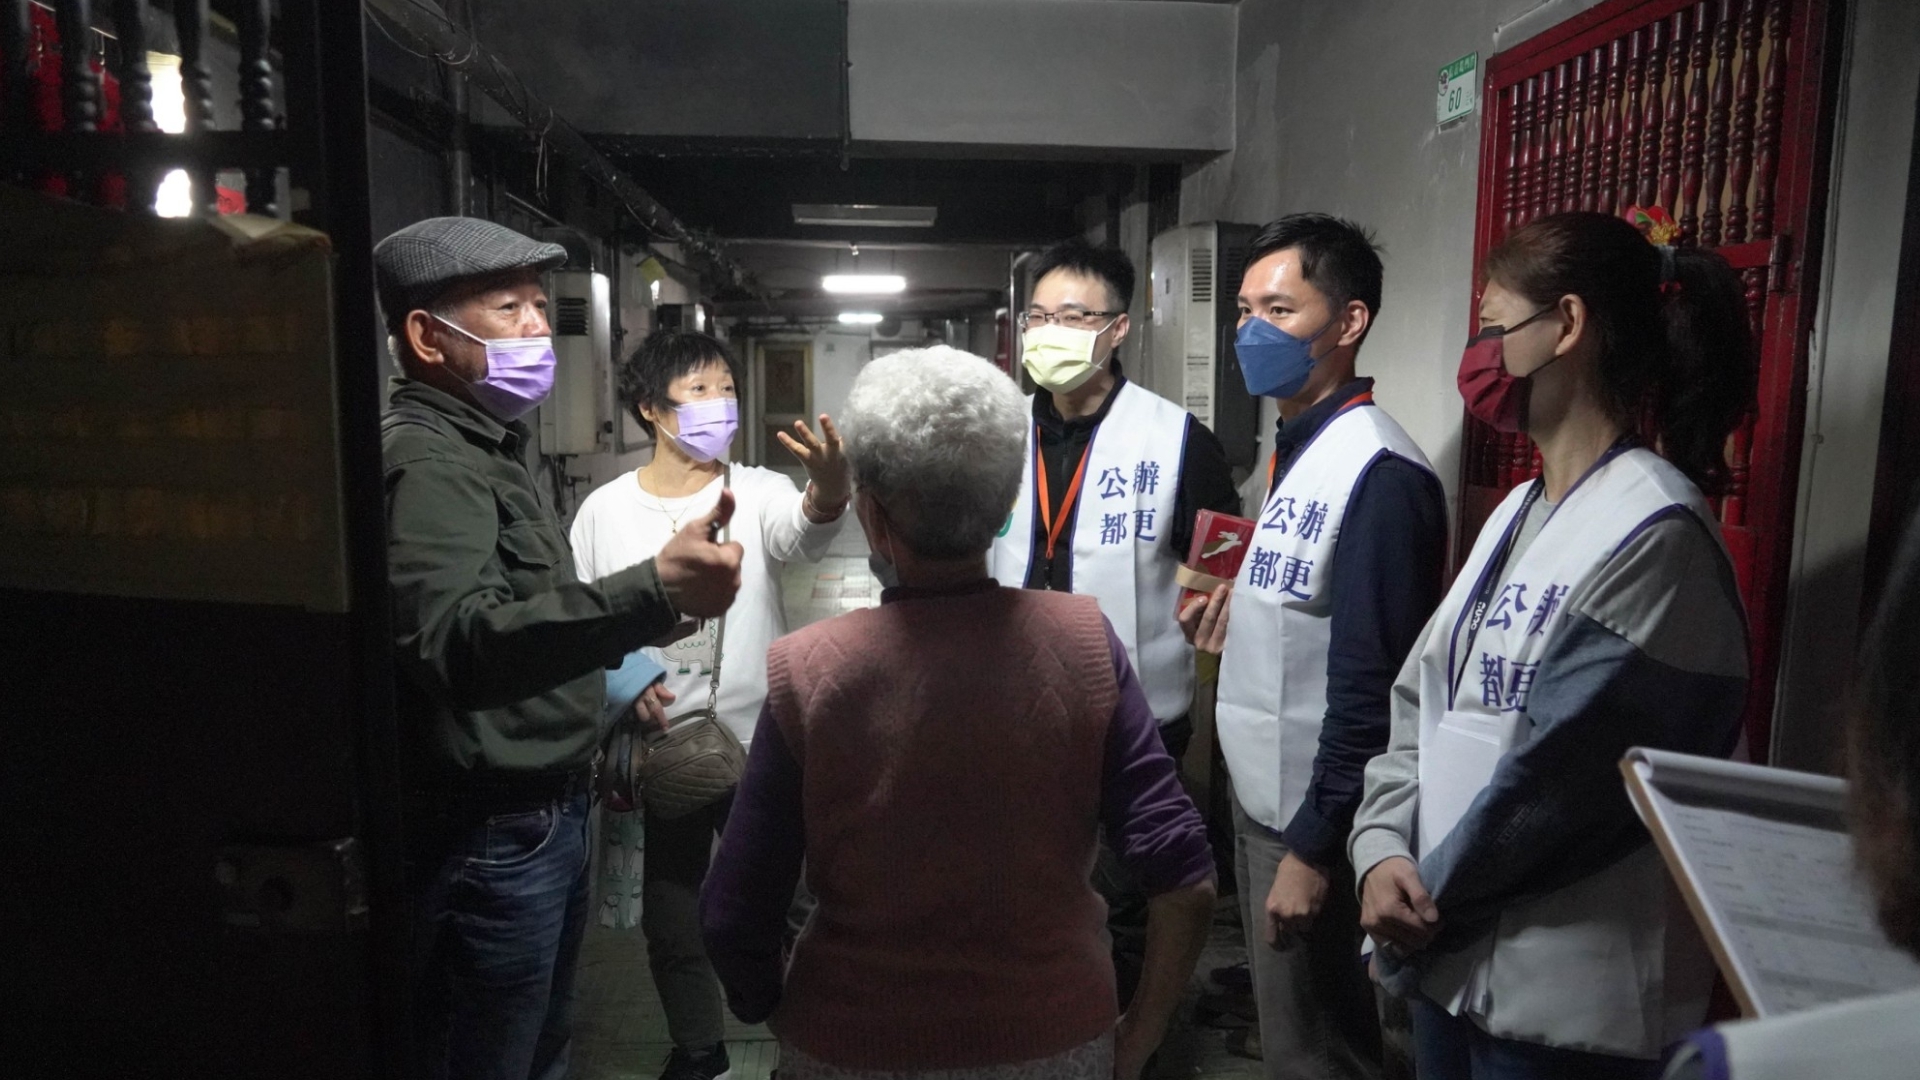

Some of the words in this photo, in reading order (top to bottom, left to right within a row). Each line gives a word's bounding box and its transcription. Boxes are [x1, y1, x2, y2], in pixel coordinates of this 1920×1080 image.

[1448, 87, 1462, 112] 60
[1097, 461, 1160, 500] 公辦
[1100, 508, 1157, 545] 都更
[1262, 498, 1328, 544] 公辦
[1249, 547, 1314, 601] 都更
